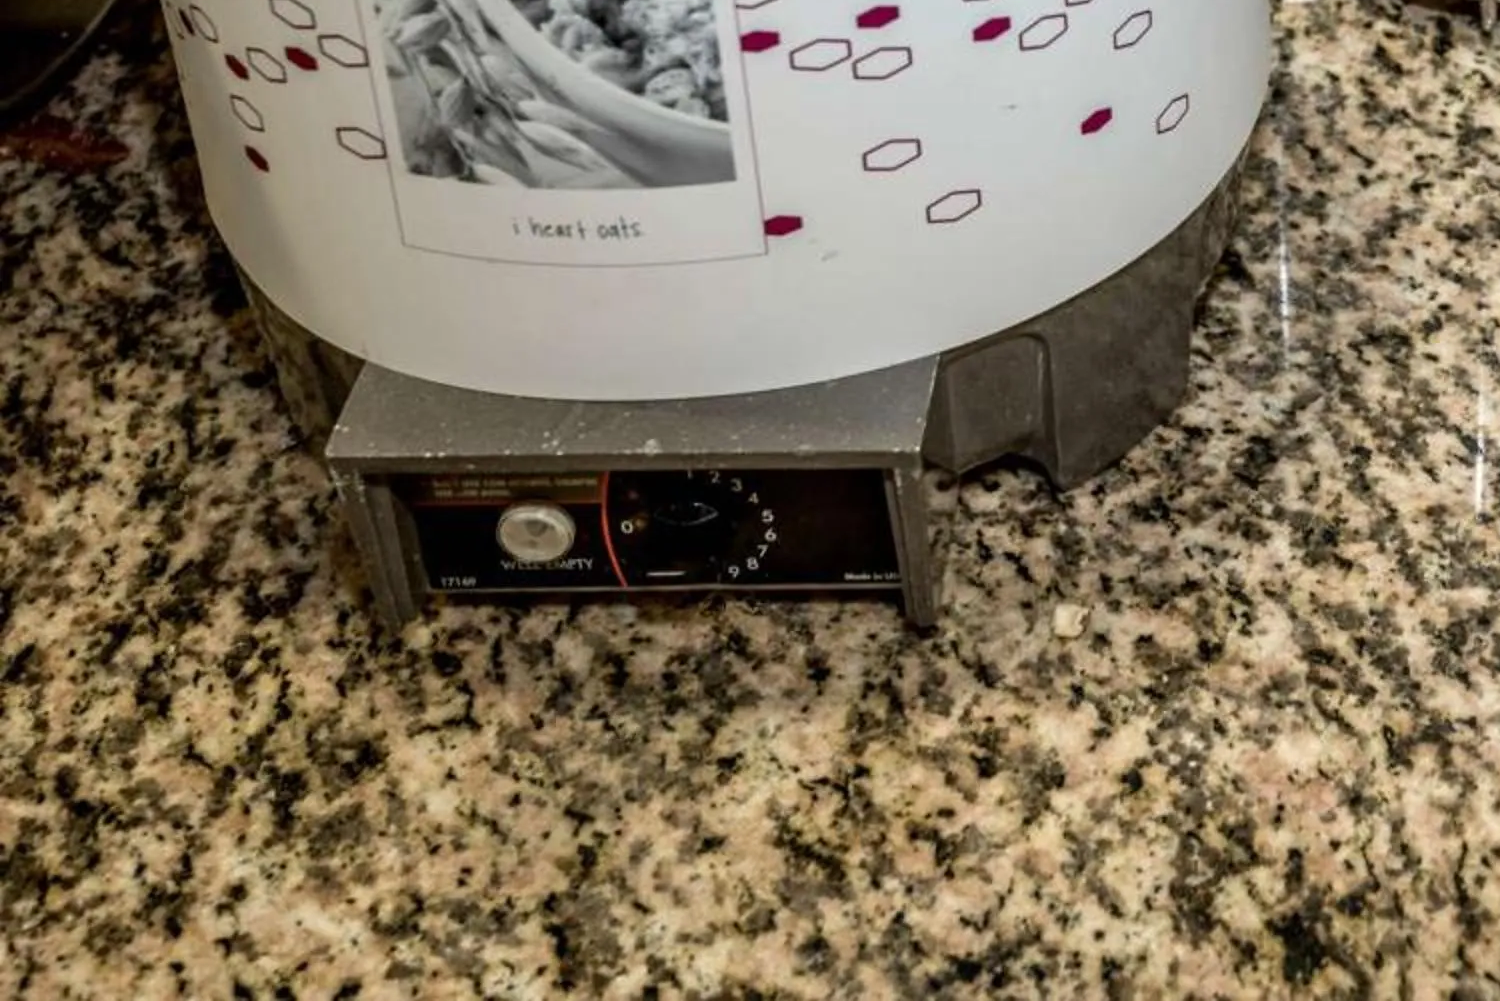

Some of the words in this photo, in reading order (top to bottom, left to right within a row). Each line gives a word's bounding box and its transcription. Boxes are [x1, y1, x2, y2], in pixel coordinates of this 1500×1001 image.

[511, 216, 521, 236] i
[528, 216, 587, 240] heart
[597, 215, 642, 241] oats
[709, 470, 720, 484] 2
[731, 478, 743, 492] 3
[748, 492, 759, 504] 4
[761, 509, 774, 523] 5
[620, 520, 634, 534] 0
[764, 528, 777, 542] 6
[757, 544, 769, 558] 7
[746, 557, 759, 570] 8
[728, 565, 740, 578] 9
